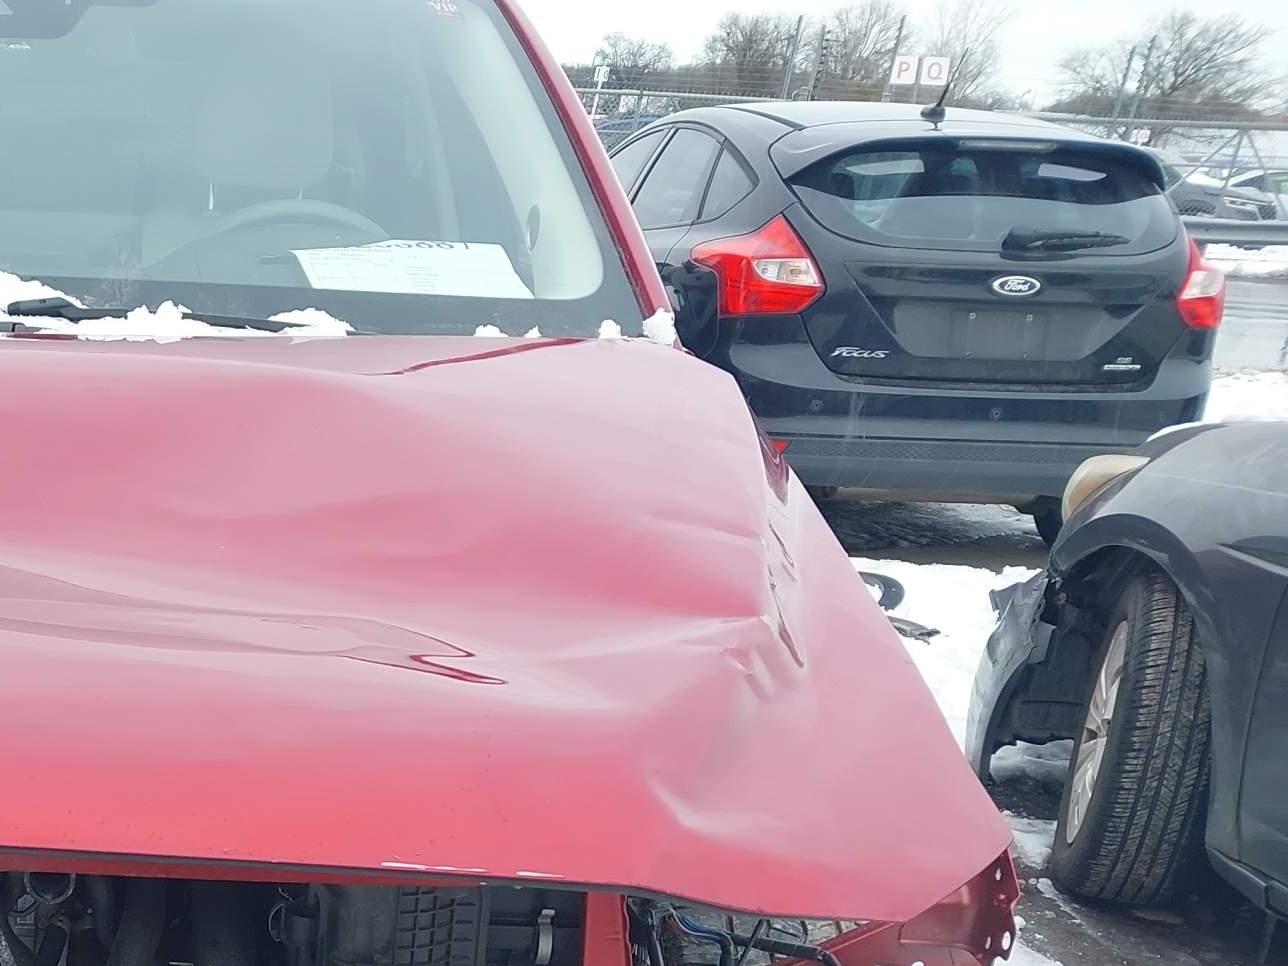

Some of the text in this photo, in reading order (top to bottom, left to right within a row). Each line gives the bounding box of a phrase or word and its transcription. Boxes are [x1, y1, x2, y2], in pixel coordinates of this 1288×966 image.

[897, 61, 910, 79] P
[927, 61, 943, 80] Q
[831, 346, 890, 358] Focus
